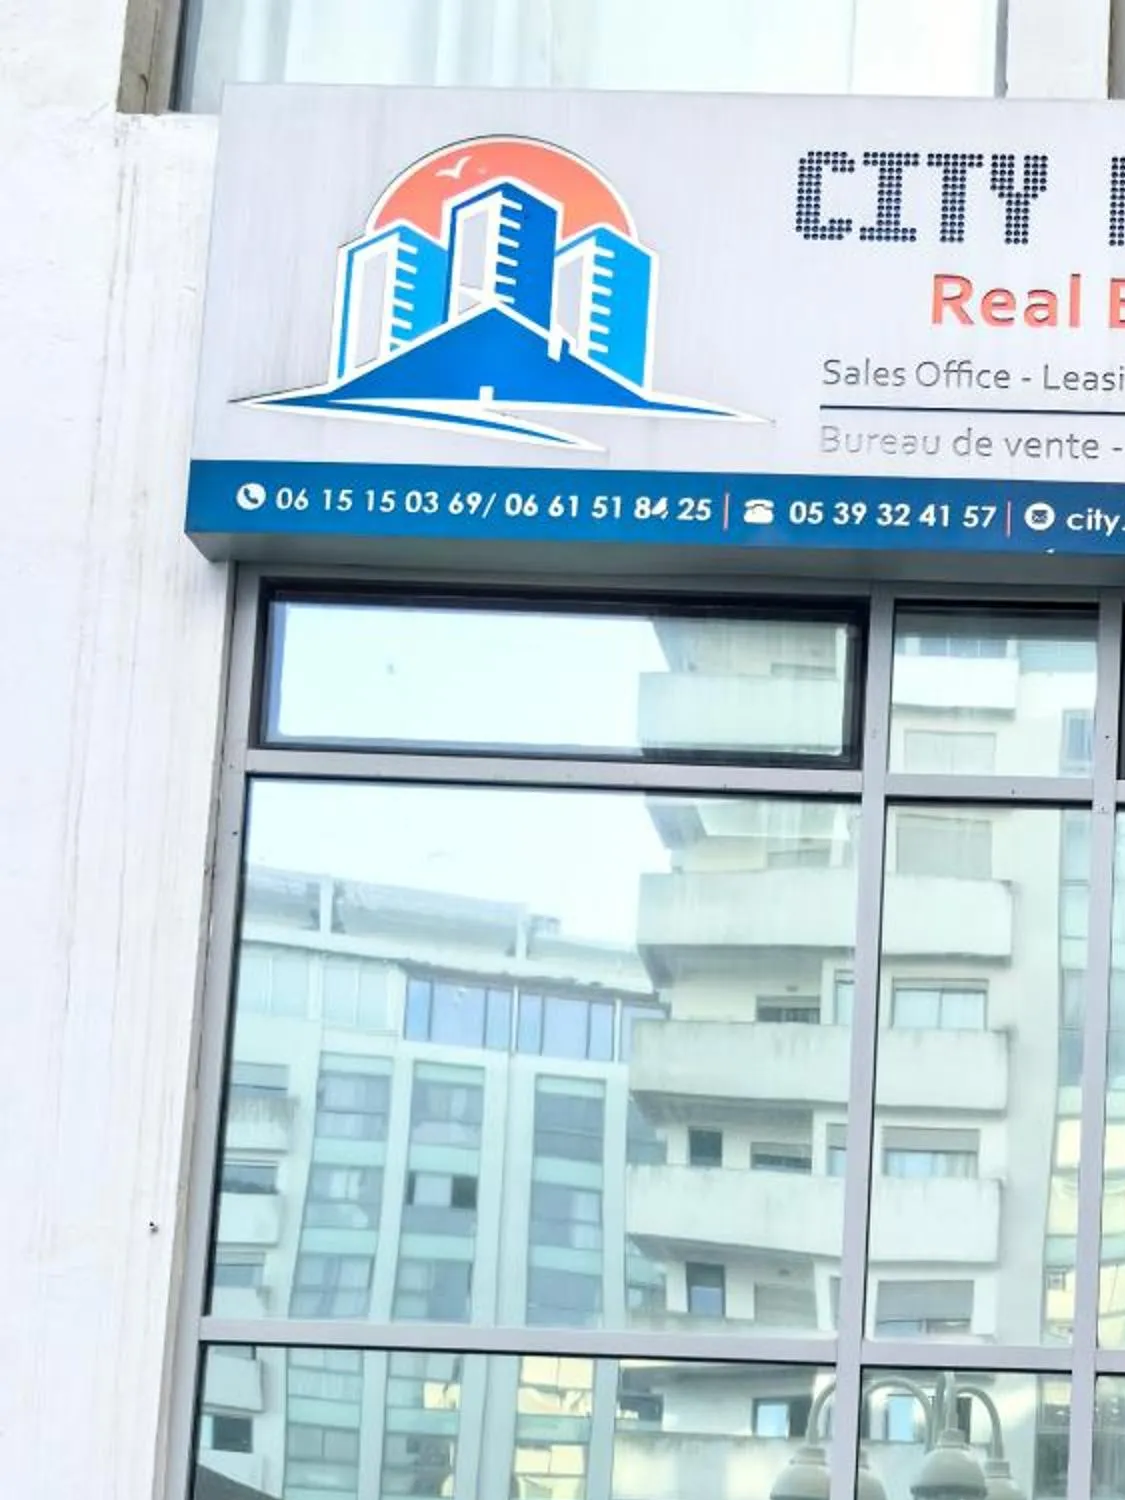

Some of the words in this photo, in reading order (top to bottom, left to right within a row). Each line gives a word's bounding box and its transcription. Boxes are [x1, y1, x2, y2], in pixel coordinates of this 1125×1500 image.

[795, 150, 1049, 246] CITY
[931, 272, 1082, 329] Real
[822, 357, 907, 388] Sales
[915, 358, 1011, 390] Office
[820, 425, 941, 456] Bureau
[952, 426, 993, 459] de
[1004, 433, 1100, 461] vente
[275, 487, 309, 511] 06
[323, 489, 353, 511] 15
[366, 490, 395, 513] 15
[405, 490, 439, 513] 03
[448, 492, 497, 519] 69/
[505, 493, 538, 517] 06
[548, 495, 579, 518] 61
[591, 496, 622, 519] 51
[677, 497, 712, 521] 25
[789, 501, 823, 525] 05
[833, 502, 867, 526] 39
[877, 503, 911, 527] 32
[919, 504, 950, 527] 41
[963, 505, 997, 528] 57
